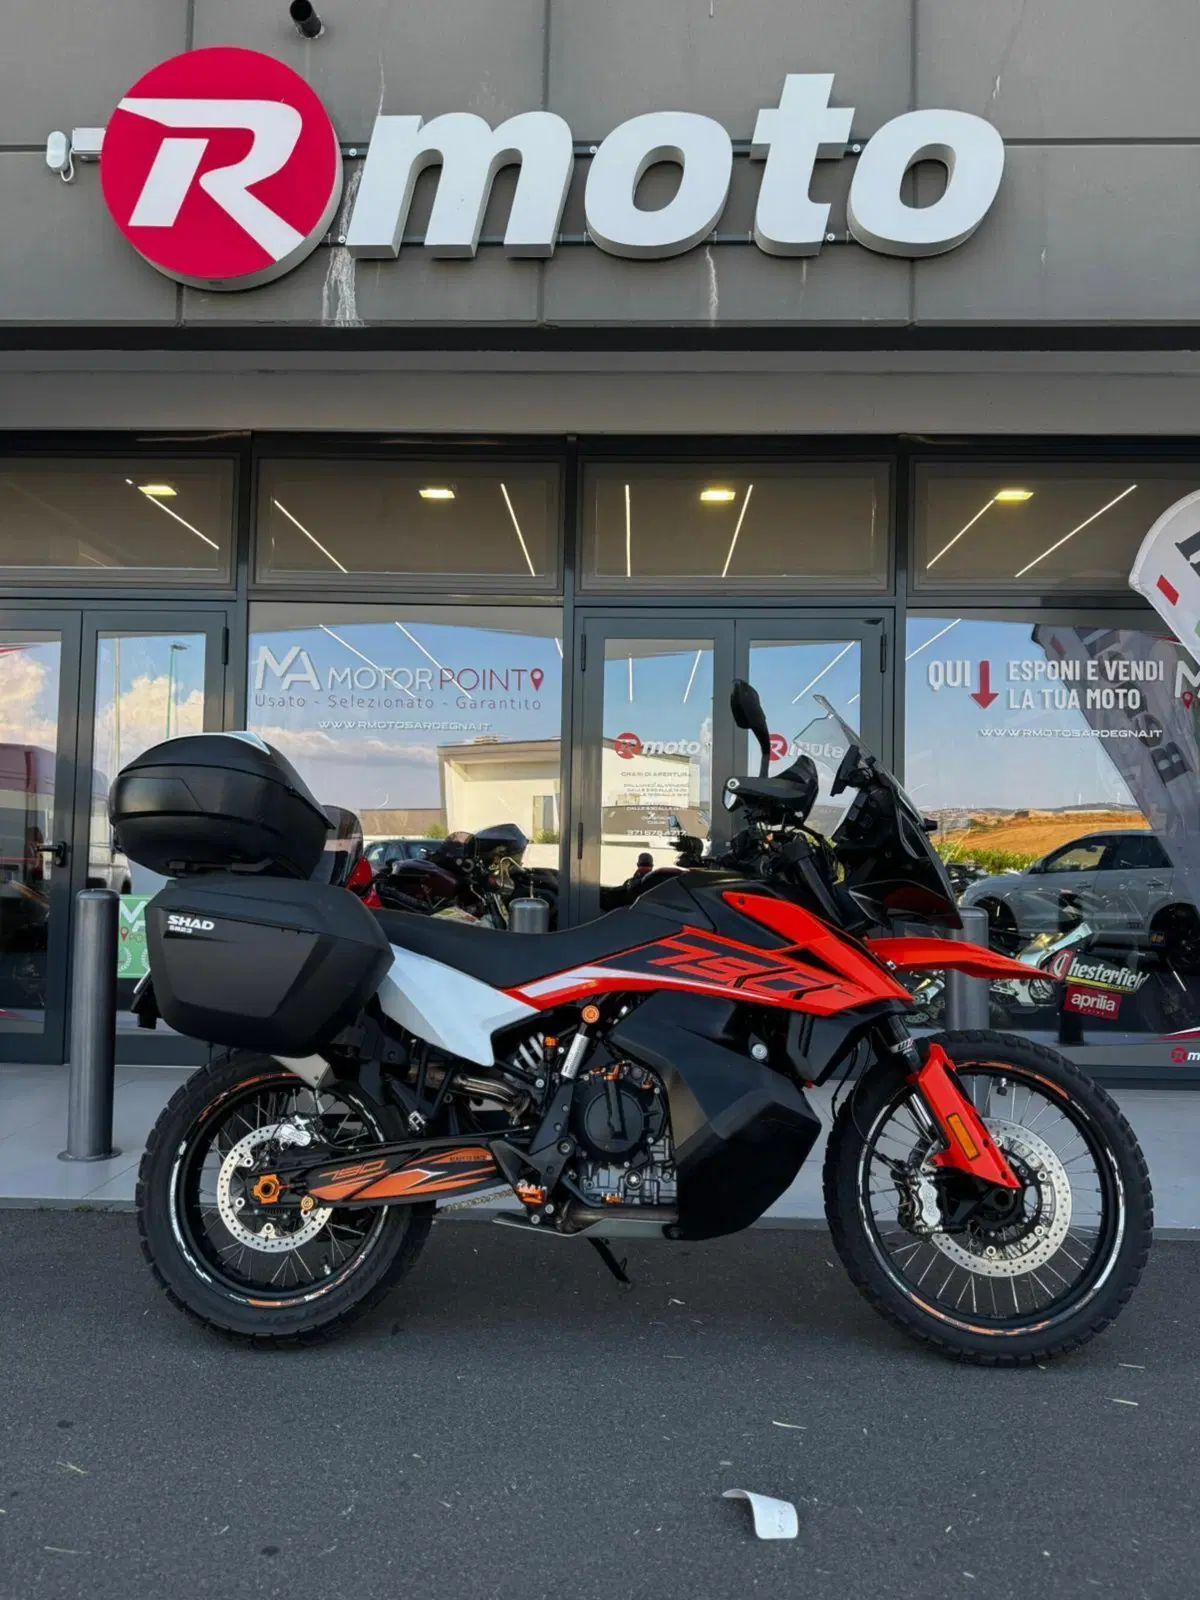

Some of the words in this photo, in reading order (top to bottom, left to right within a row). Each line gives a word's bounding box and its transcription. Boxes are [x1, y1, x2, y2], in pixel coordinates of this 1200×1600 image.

[117, 97, 306, 263] R
[346, 73, 1005, 258] moto
[928, 661, 971, 691] QUI
[1009, 660, 1080, 681] ESPONI
[1087, 660, 1099, 681] E
[1104, 660, 1164, 681] VENDI
[255, 694, 306, 708] Usato
[328, 694, 434, 709] Selezionato
[456, 696, 542, 710] Garantito
[1010, 689, 1035, 710] LA
[1041, 689, 1080, 710] TUA
[1086, 689, 1141, 710] MOTO
[167, 914, 215, 931] SHAD
[1071, 993, 1116, 1012] aprilia
